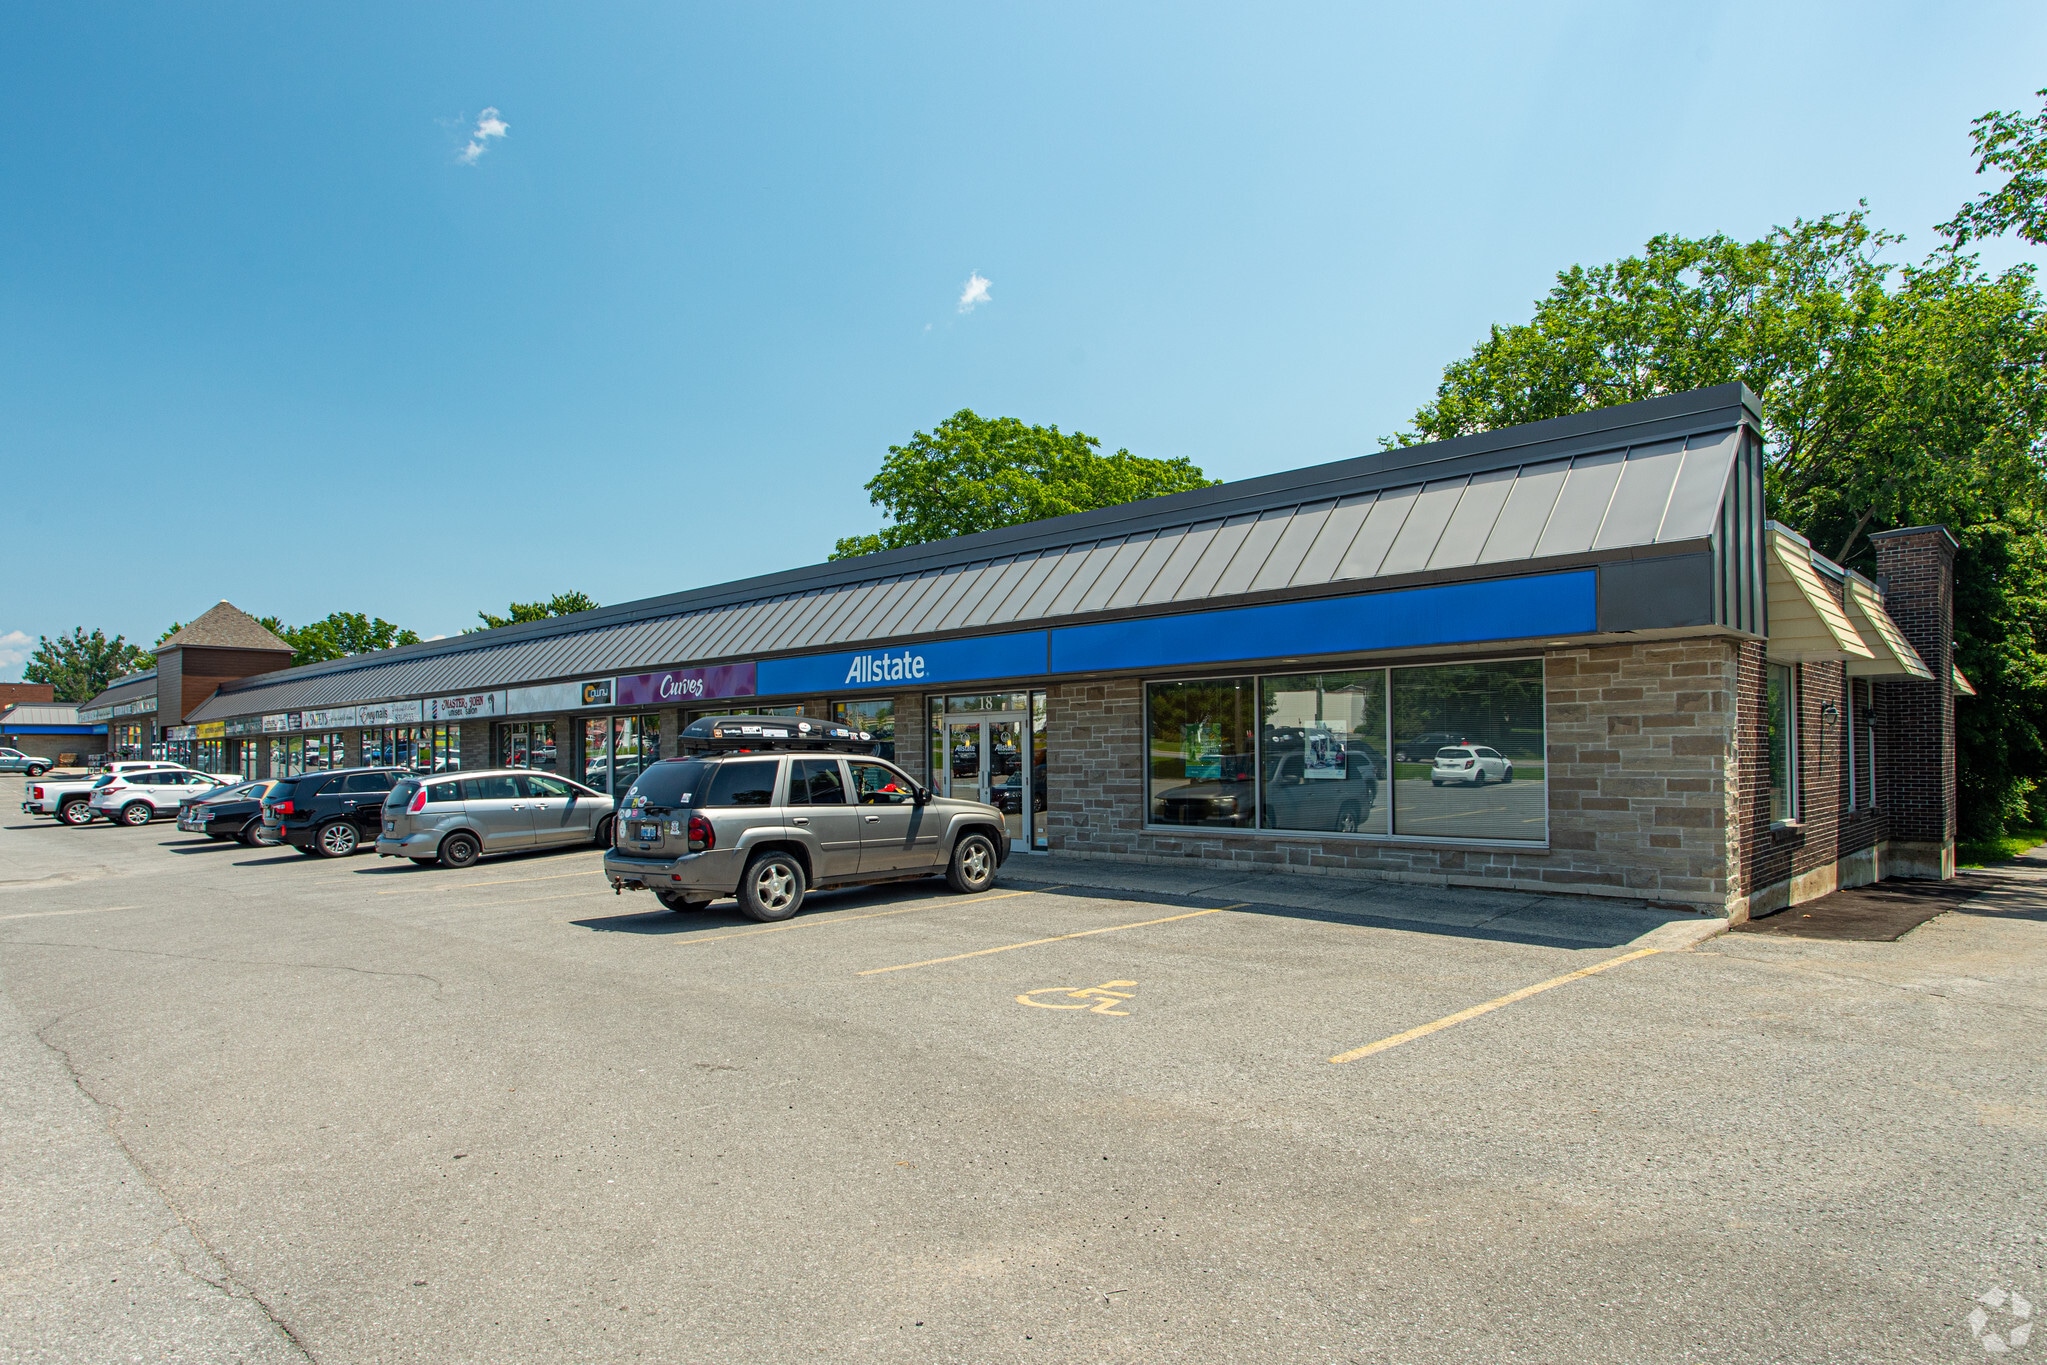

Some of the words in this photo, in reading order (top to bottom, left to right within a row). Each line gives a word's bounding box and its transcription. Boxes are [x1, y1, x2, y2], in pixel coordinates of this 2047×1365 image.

[845, 651, 925, 684] Allstate
[660, 674, 704, 698] Curves
[441, 697, 468, 711] MASTER
[468, 695, 484, 709] JOHN
[979, 695, 993, 710] 18
[376, 707, 388, 719] nails
[465, 707, 478, 715] salon
